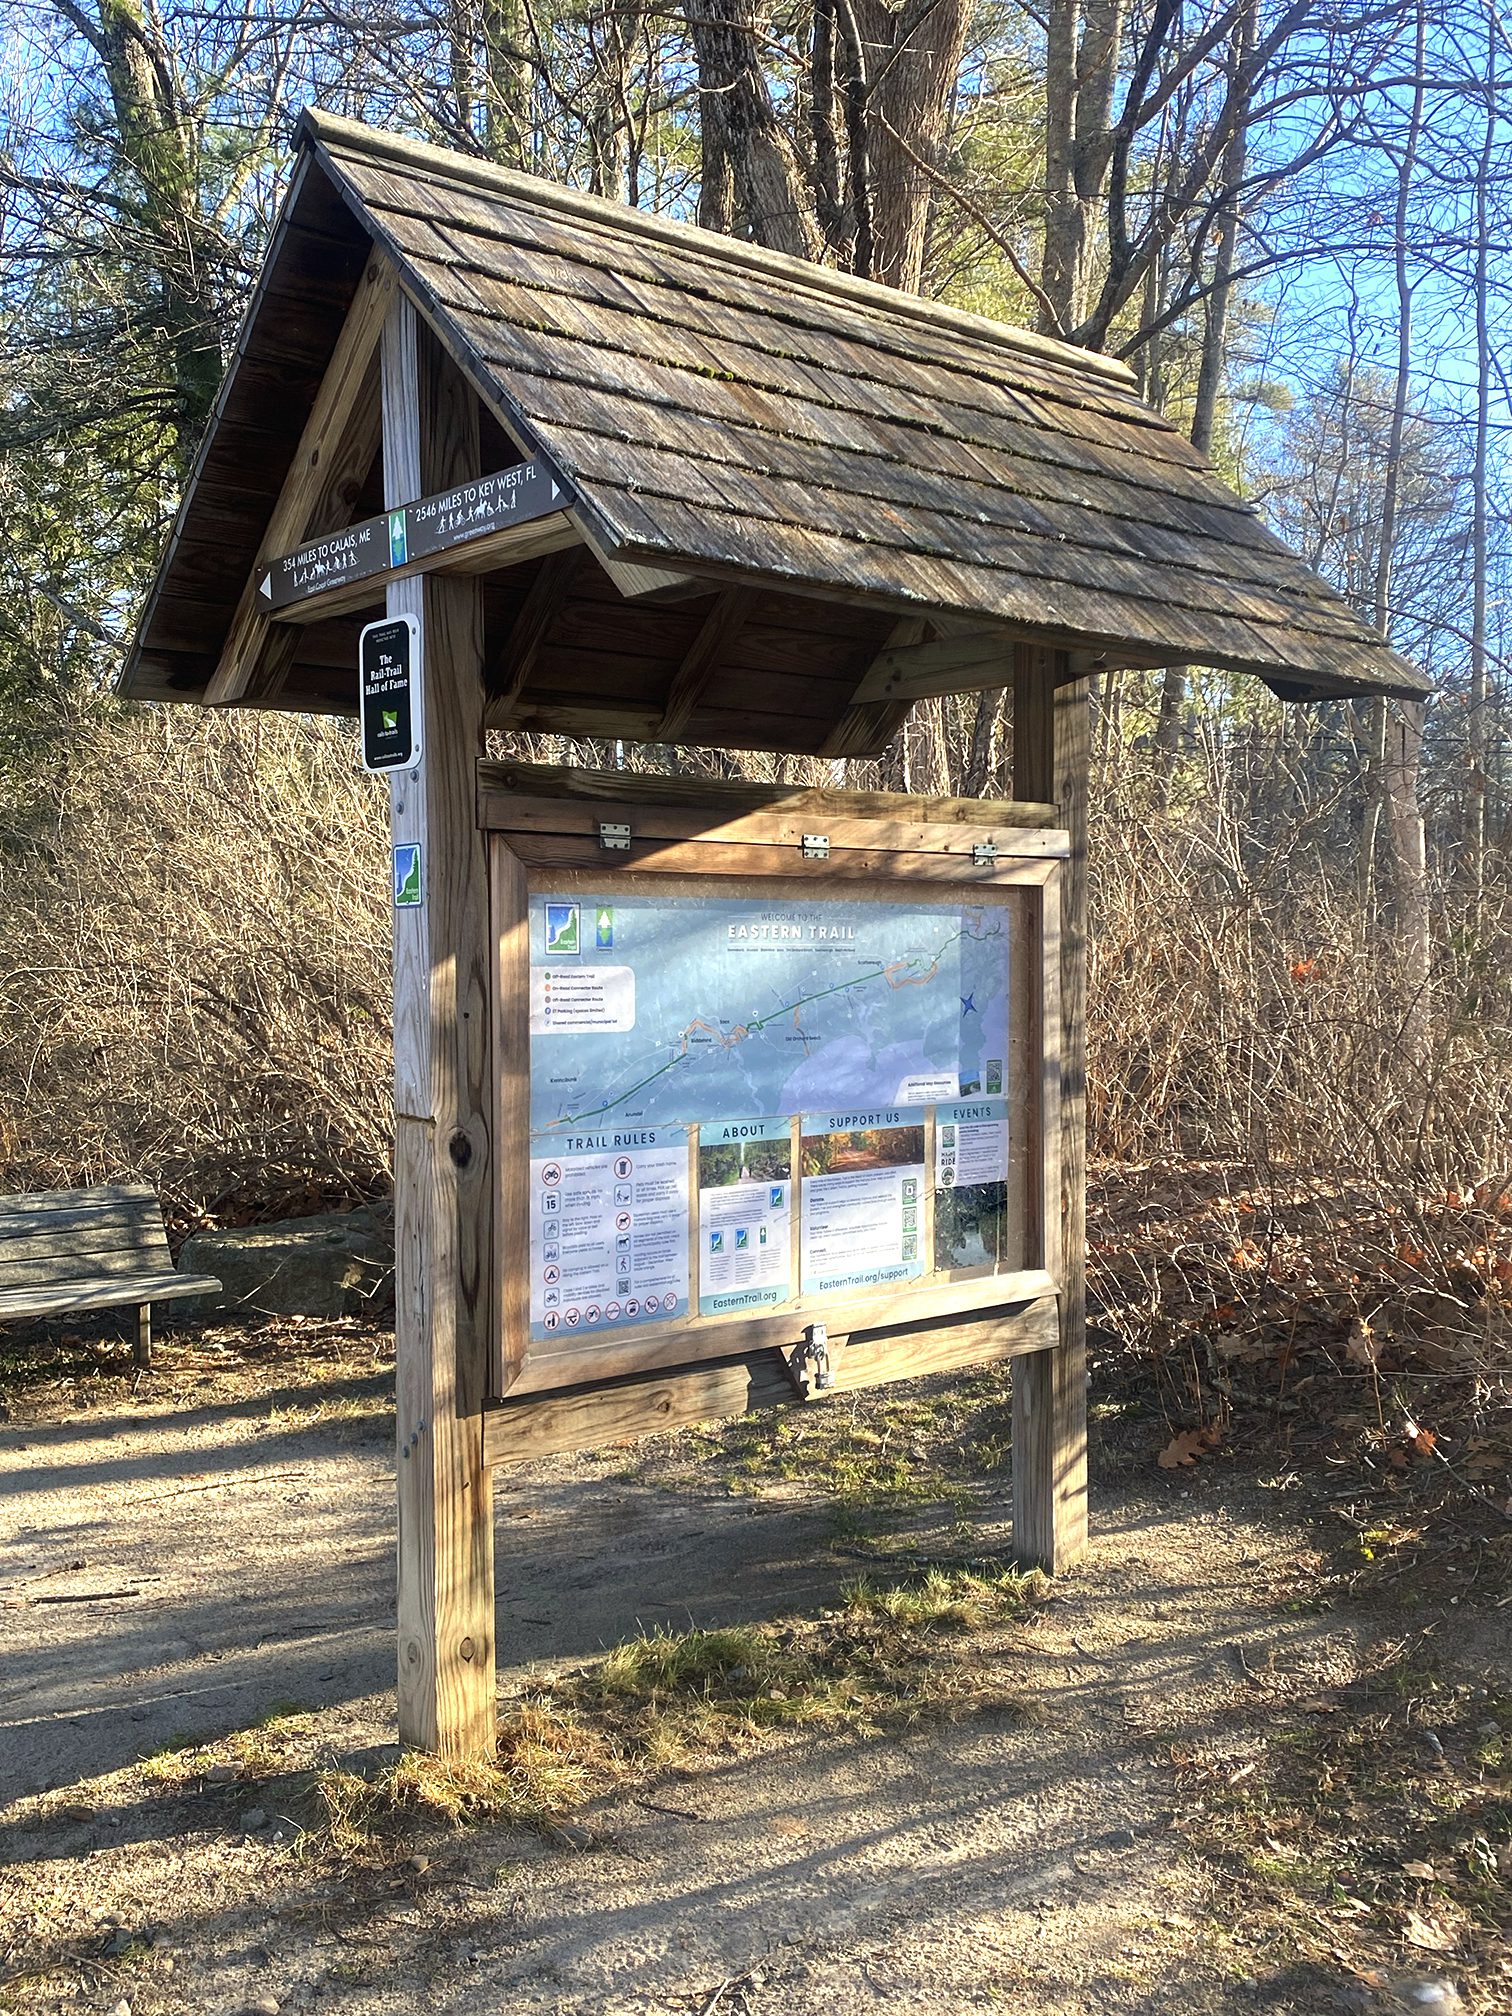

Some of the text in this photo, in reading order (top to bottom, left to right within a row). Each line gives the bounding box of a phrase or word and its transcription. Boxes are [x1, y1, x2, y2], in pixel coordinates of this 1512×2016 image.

[415, 465, 537, 523] 2546 MILES TO KEY WEST, FL
[282, 528, 371, 572] 354 MILES TO CALAIS, ME
[379, 654, 393, 666] The
[370, 664, 402, 681] Rail-Trail
[365, 678, 408, 696] Hall of Fame
[760, 913, 823, 922] WELCOME TO THE
[727, 924, 855, 940] EASTERN TRAIL
[829, 1112, 900, 1128] SUPPORT US
[953, 1106, 992, 1120] EVENTS
[722, 1124, 766, 1139] ABOUT
[566, 1132, 656, 1150] TRAIL RULES
[546, 1200, 556, 1210] 15
[819, 1267, 909, 1291] EasternTrail.org/support
[713, 1290, 777, 1309] EasternTrail.org
